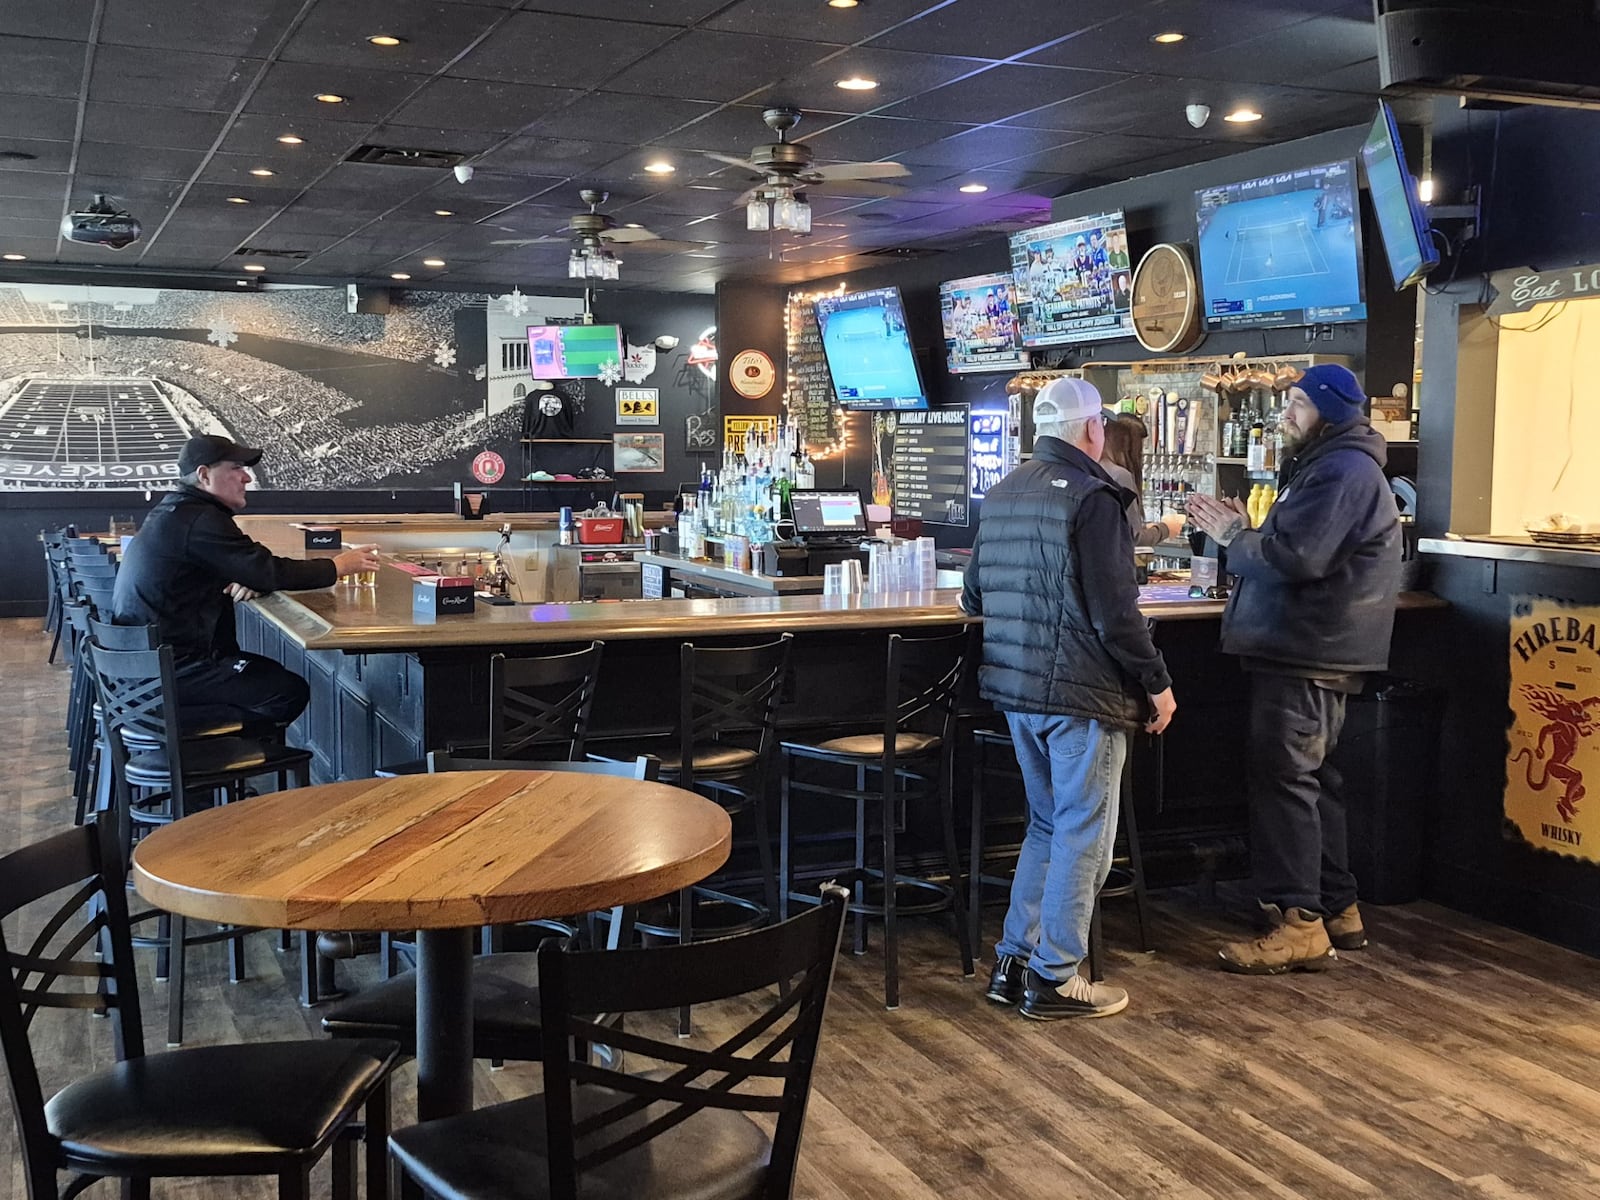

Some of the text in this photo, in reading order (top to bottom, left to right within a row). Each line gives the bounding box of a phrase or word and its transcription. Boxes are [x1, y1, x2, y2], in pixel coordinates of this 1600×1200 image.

[1511, 275, 1565, 307] Eat
[899, 410, 965, 424] JANUARY LIVE MUSIC
[1513, 616, 1600, 664] FIREBA
[1541, 822, 1582, 846] WHISKY
